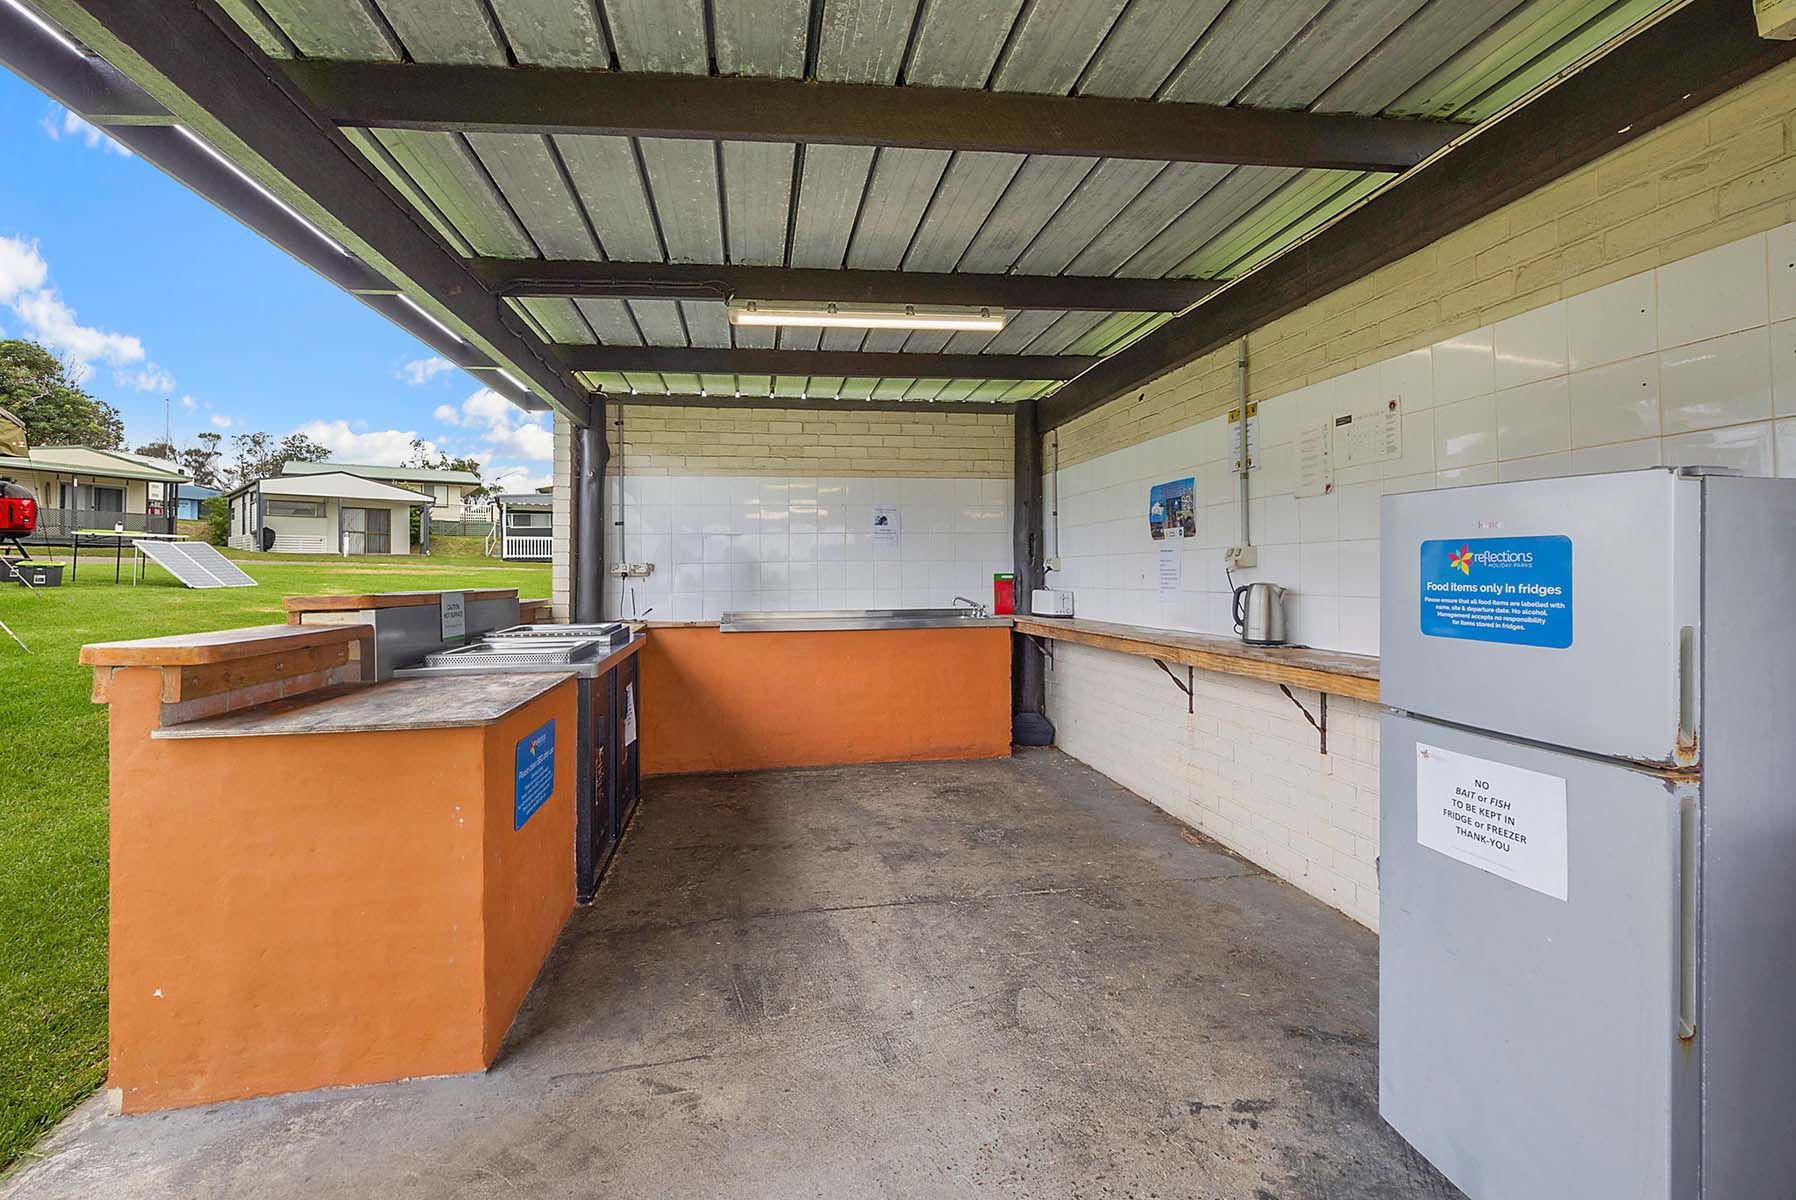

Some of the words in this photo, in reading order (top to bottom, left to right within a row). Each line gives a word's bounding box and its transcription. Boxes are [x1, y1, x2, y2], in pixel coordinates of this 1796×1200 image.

[1474, 549, 1533, 566] reflections
[1426, 582, 1449, 592] Food
[1450, 582, 1478, 592] items
[1480, 583, 1503, 596] only
[1505, 583, 1516, 594] in
[1518, 584, 1562, 597] fridges
[1437, 611, 1471, 619] Management
[1503, 616, 1546, 625] responsibility
[1522, 608, 1548, 616] alcohol.
[1502, 622, 1526, 631] fridges.
[1474, 779, 1490, 790] NO
[1455, 787, 1476, 799] BAIT
[1477, 795, 1488, 803] or
[1489, 797, 1511, 810] FISH
[1451, 798, 1464, 809] TO
[1465, 803, 1477, 814] BE
[1479, 807, 1502, 821] KEPT
[1504, 815, 1515, 826] IN
[1443, 808, 1472, 825] FRIDGE
[1474, 821, 1485, 829] or
[1486, 823, 1527, 844] FREEZER
[1455, 825, 1510, 853] THANK-YOU
